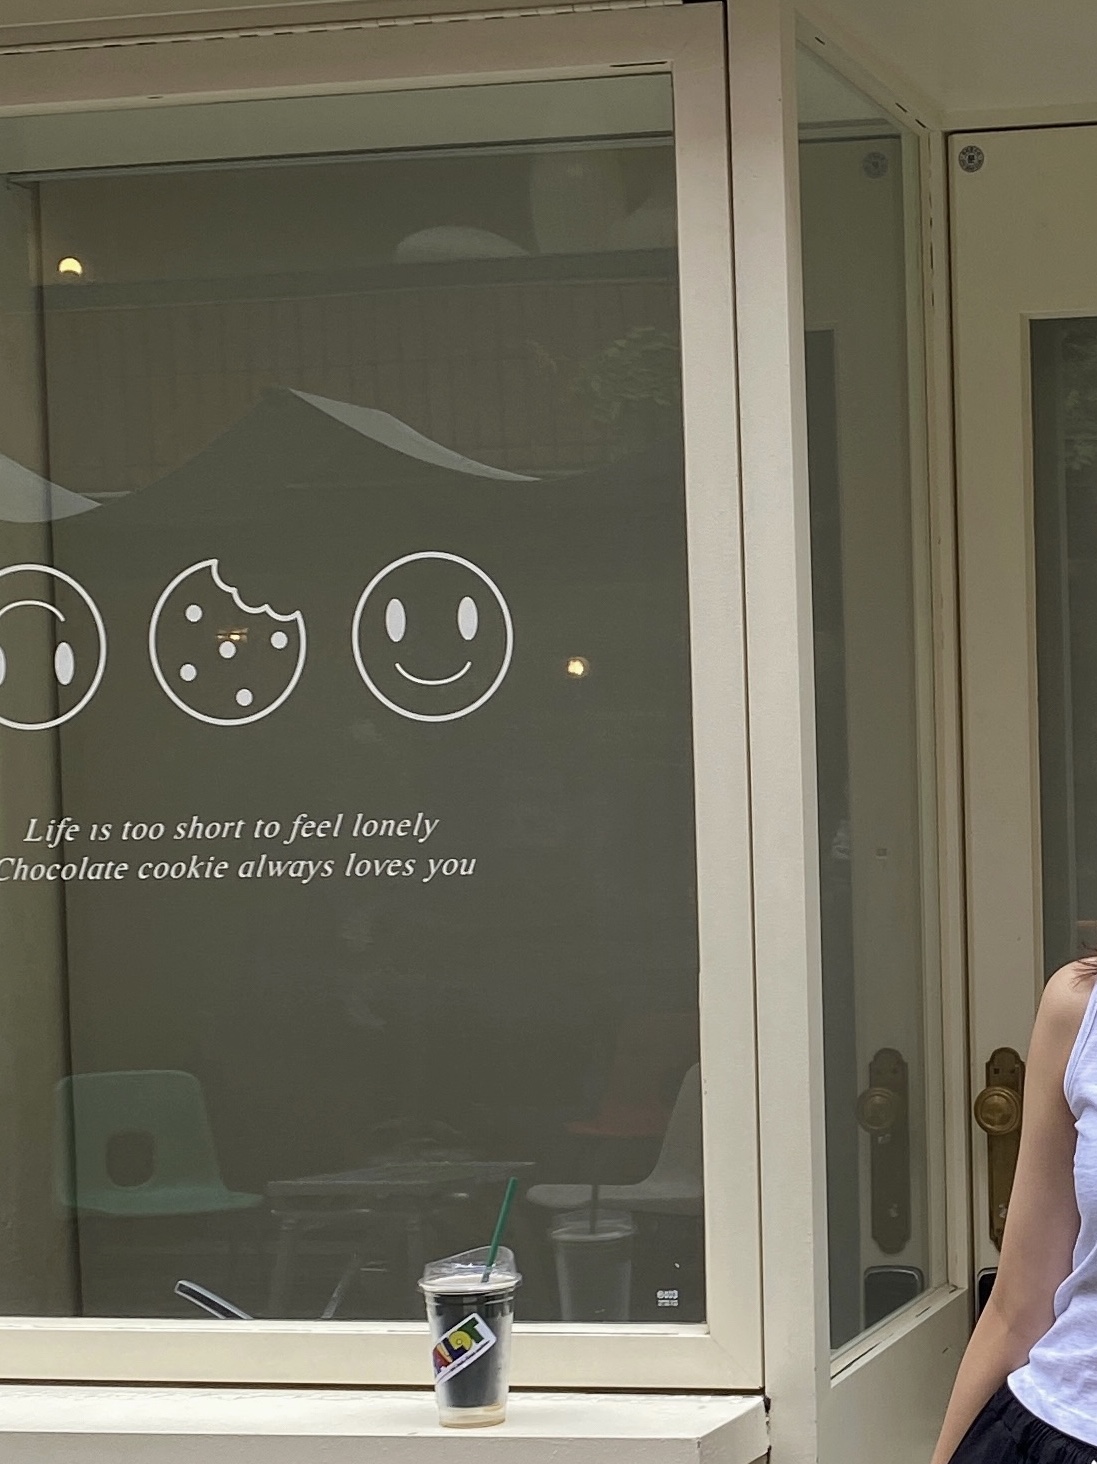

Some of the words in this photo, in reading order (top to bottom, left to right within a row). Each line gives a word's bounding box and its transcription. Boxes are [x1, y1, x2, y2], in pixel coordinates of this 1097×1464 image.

[22, 817, 80, 849] Life
[89, 823, 113, 842] is
[121, 820, 165, 842] too
[173, 815, 246, 841] short
[253, 818, 281, 840] to
[282, 813, 344, 845] feel
[352, 812, 440, 843] lonely
[0, 856, 129, 882] Chocolate
[137, 854, 229, 881] cookie
[237, 853, 335, 884] always
[344, 852, 417, 878] loves
[422, 857, 477, 883] you
